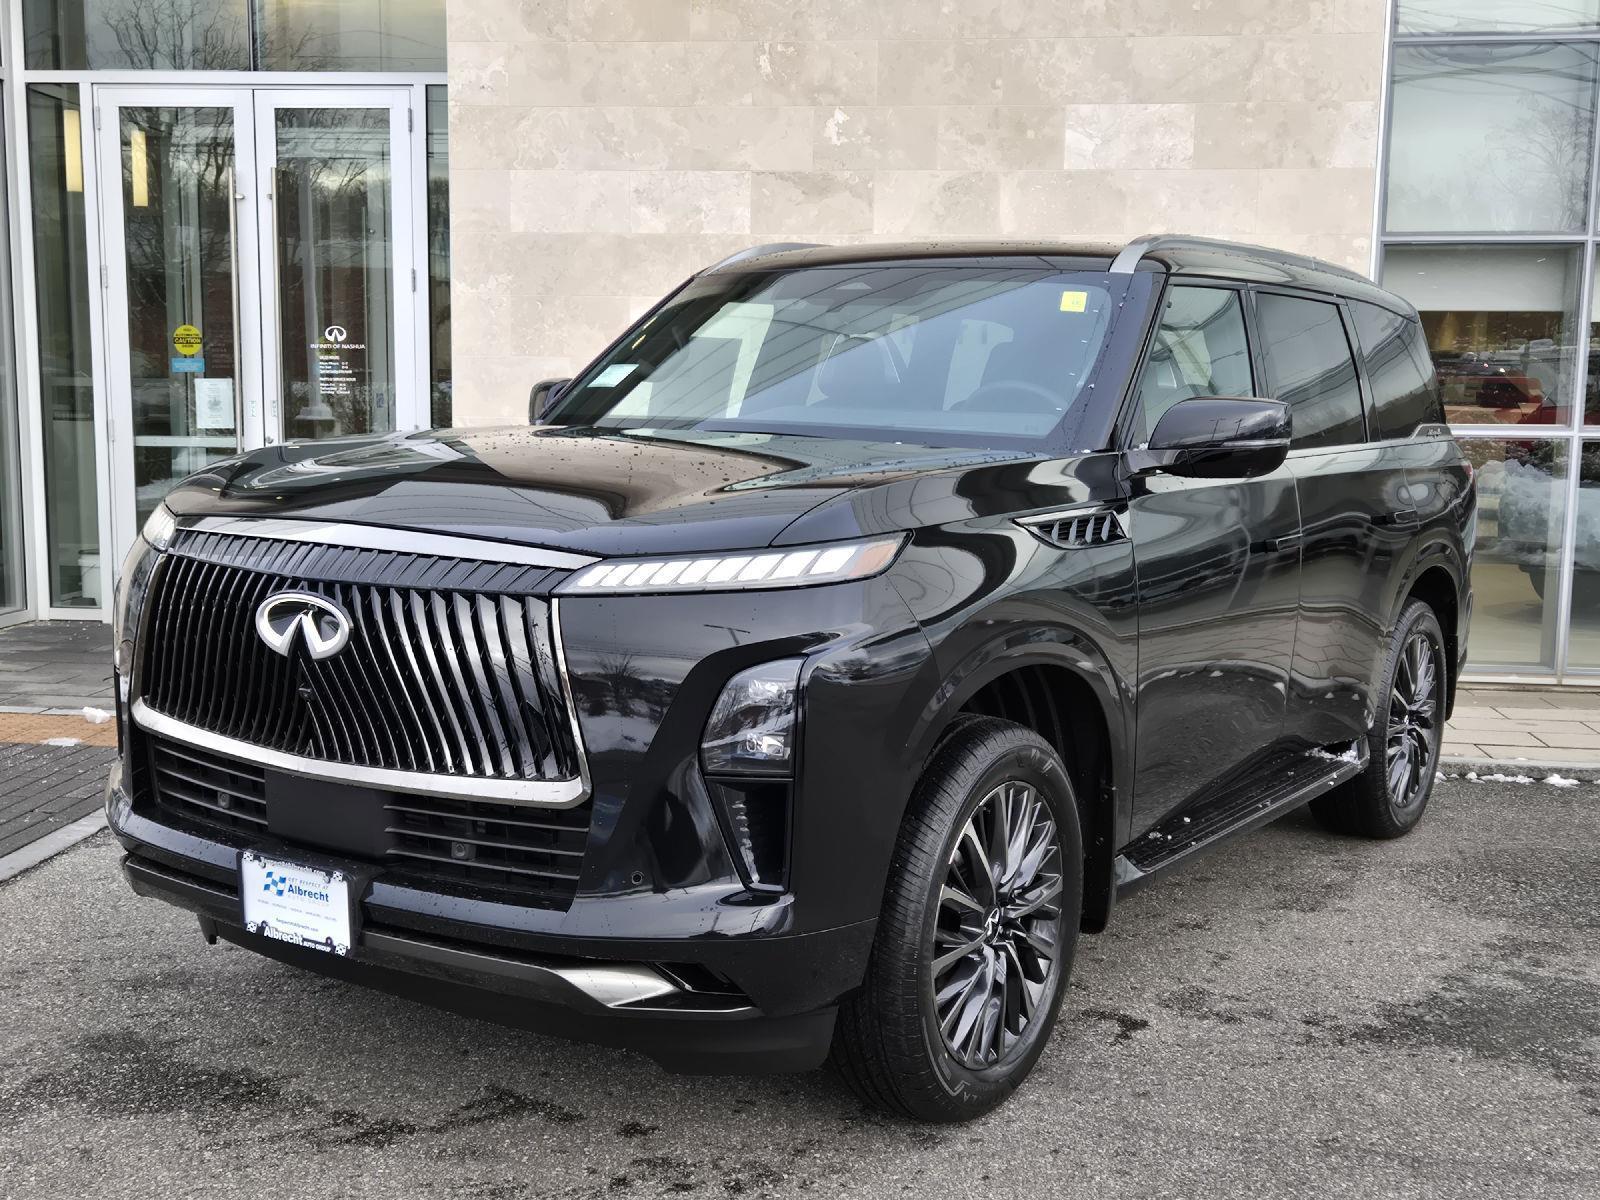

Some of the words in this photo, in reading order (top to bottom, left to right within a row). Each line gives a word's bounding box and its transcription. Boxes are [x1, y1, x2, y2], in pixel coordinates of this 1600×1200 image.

[288, 884, 329, 902] Albrecht
[264, 926, 303, 946] Albrecht
[303, 941, 315, 949] AUTO
[315, 942, 332, 953] GROUP
